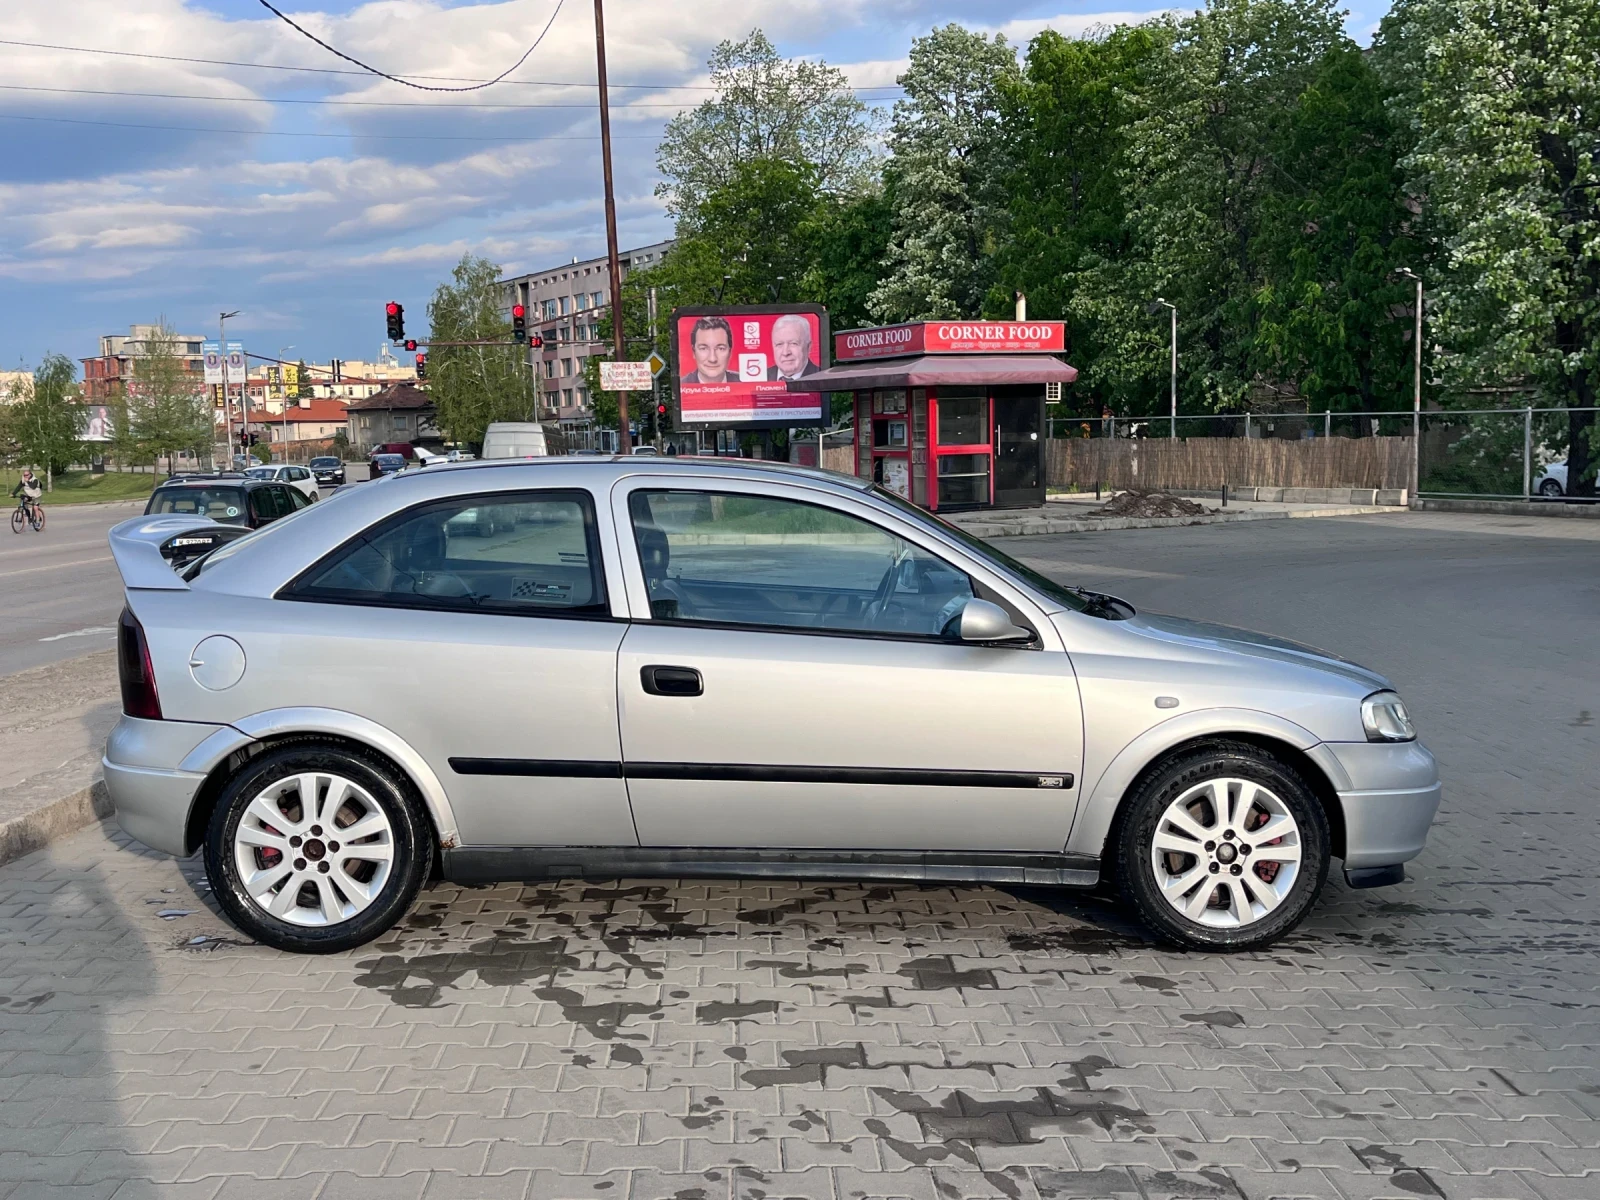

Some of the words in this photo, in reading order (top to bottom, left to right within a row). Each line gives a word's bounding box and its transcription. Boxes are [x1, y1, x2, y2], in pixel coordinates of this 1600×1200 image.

[847, 332, 883, 349] CORNER
[885, 328, 912, 344] FOOD
[938, 326, 1005, 340] CORNER
[1008, 326, 1052, 340] FOOD
[746, 359, 761, 377] 5
[680, 386, 701, 394] Крум
